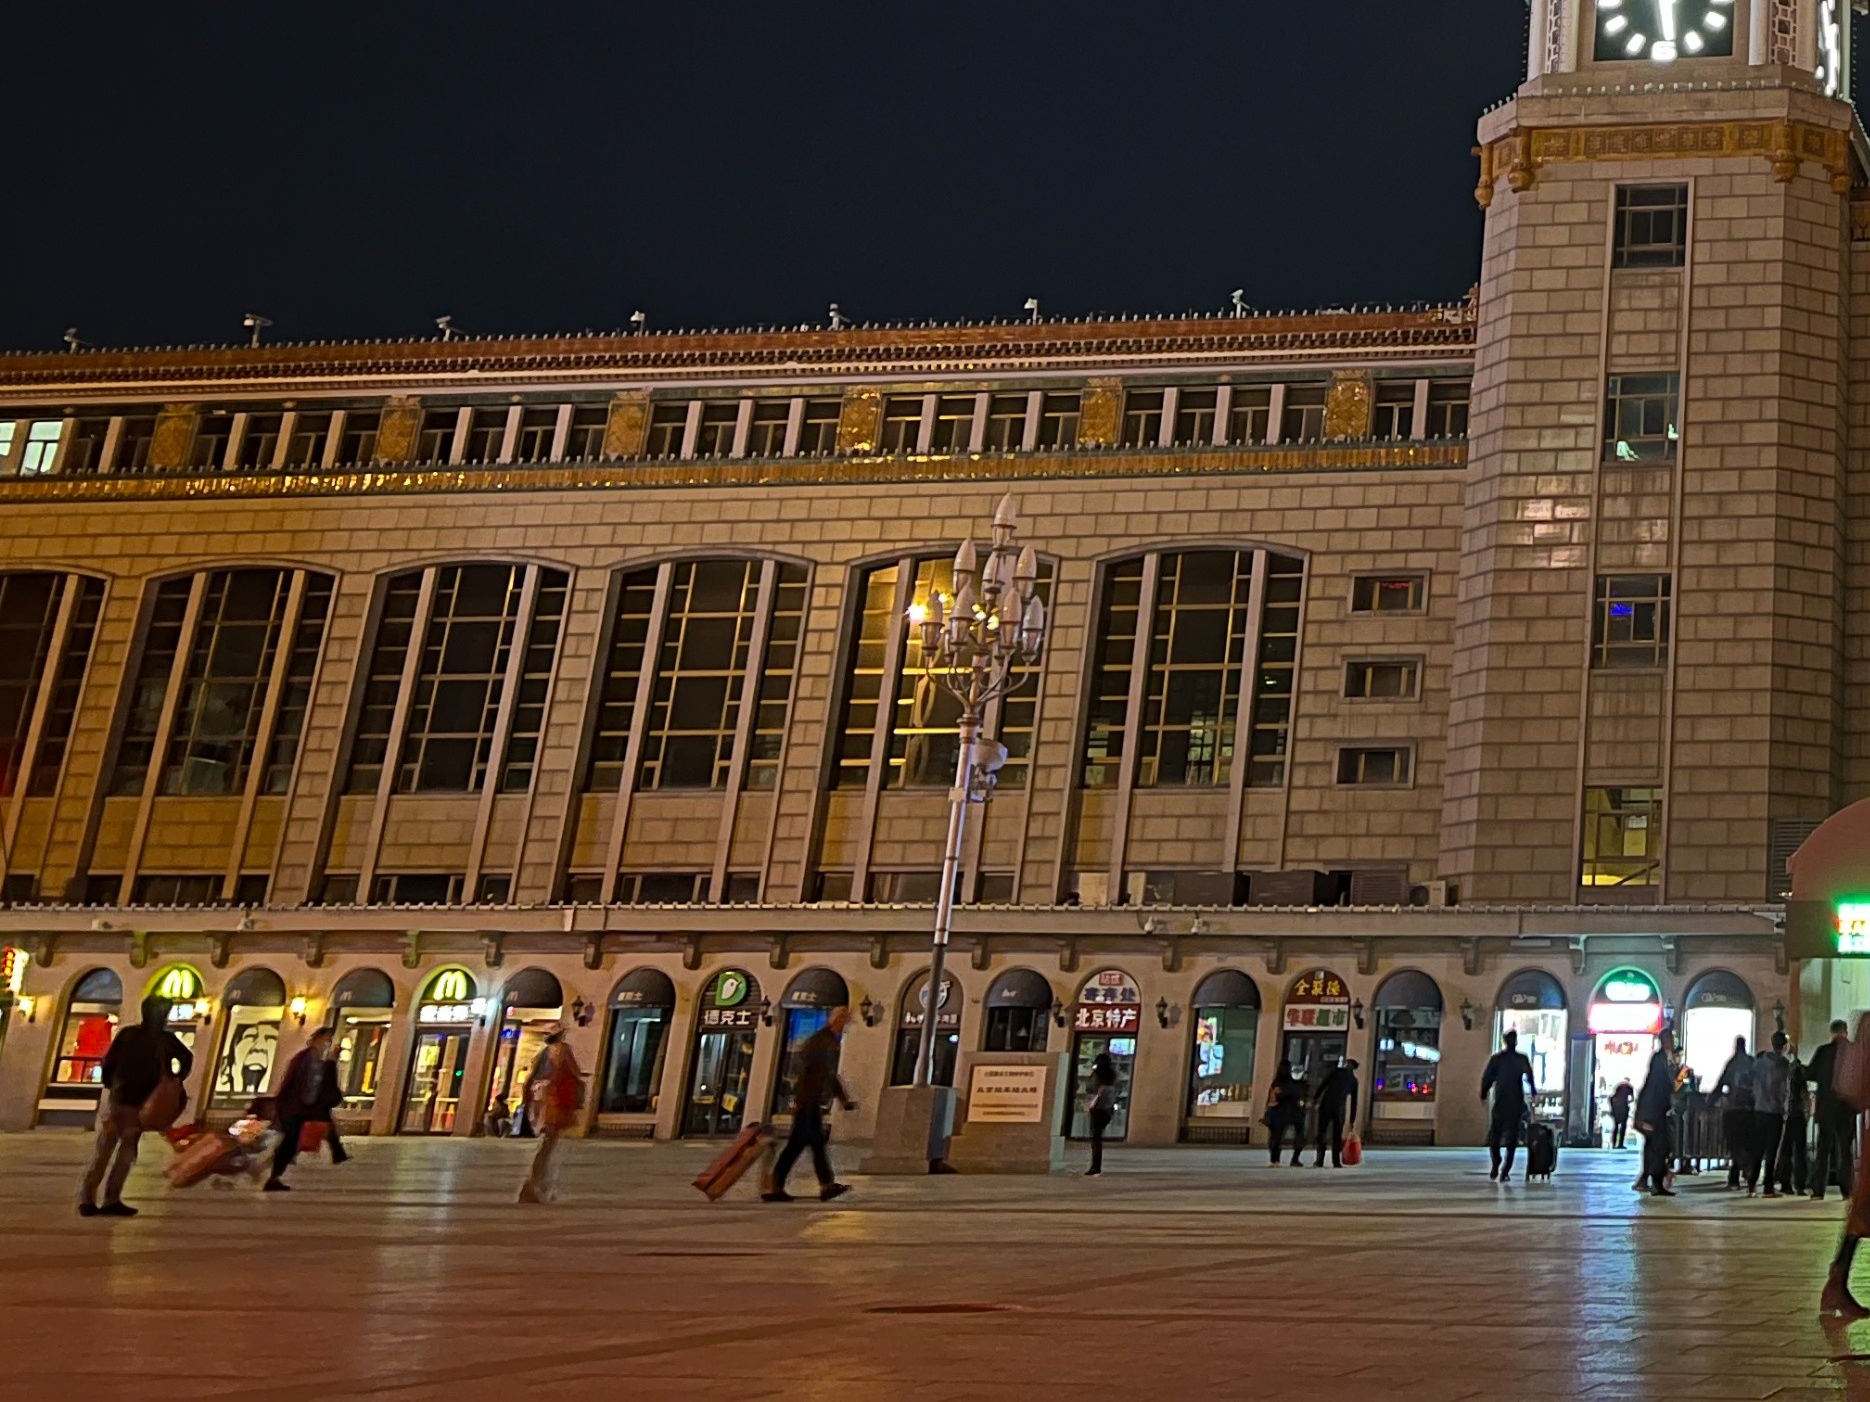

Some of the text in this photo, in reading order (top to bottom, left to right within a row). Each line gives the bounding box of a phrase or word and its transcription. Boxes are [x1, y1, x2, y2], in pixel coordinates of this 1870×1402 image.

[704, 1009, 752, 1026] 德克士
[1075, 1008, 1137, 1028] 北京特产
